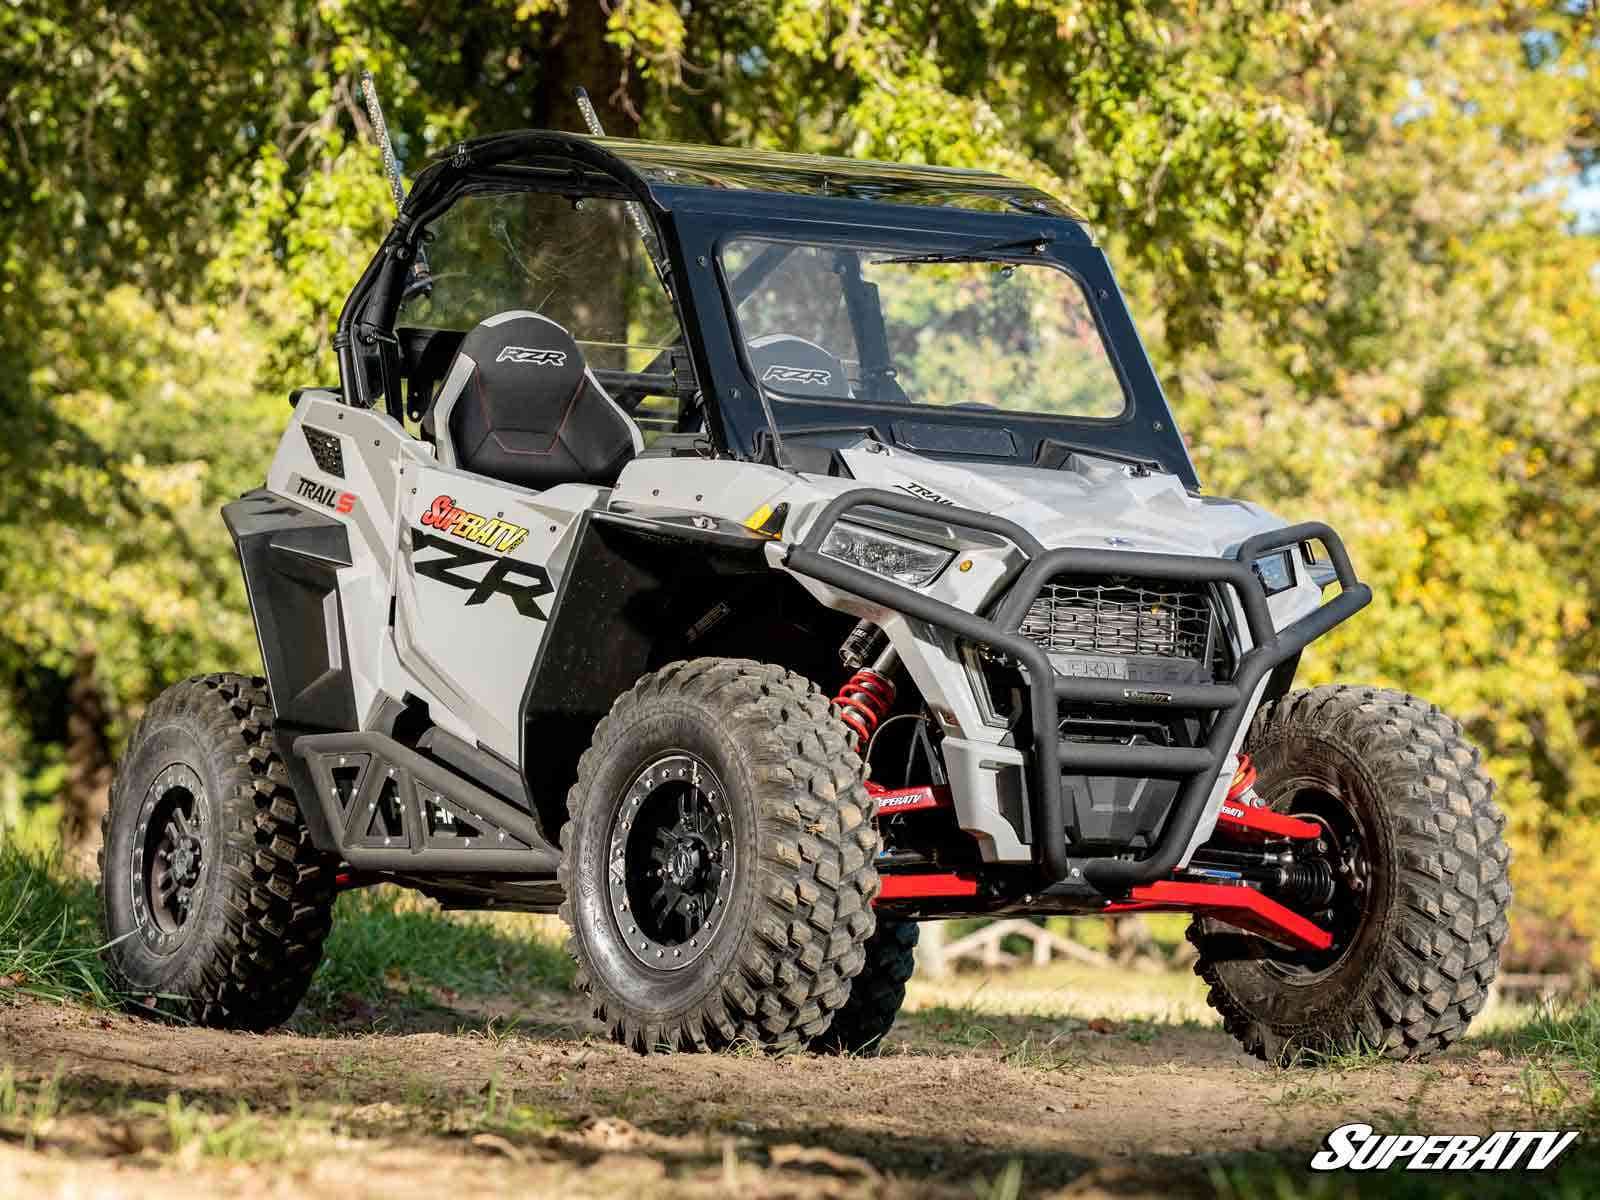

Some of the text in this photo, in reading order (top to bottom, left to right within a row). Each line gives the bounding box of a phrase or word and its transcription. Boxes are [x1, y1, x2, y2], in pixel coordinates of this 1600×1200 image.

[496, 345, 567, 367] RZR
[762, 365, 832, 386] RZR
[296, 477, 337, 508] TRAIL
